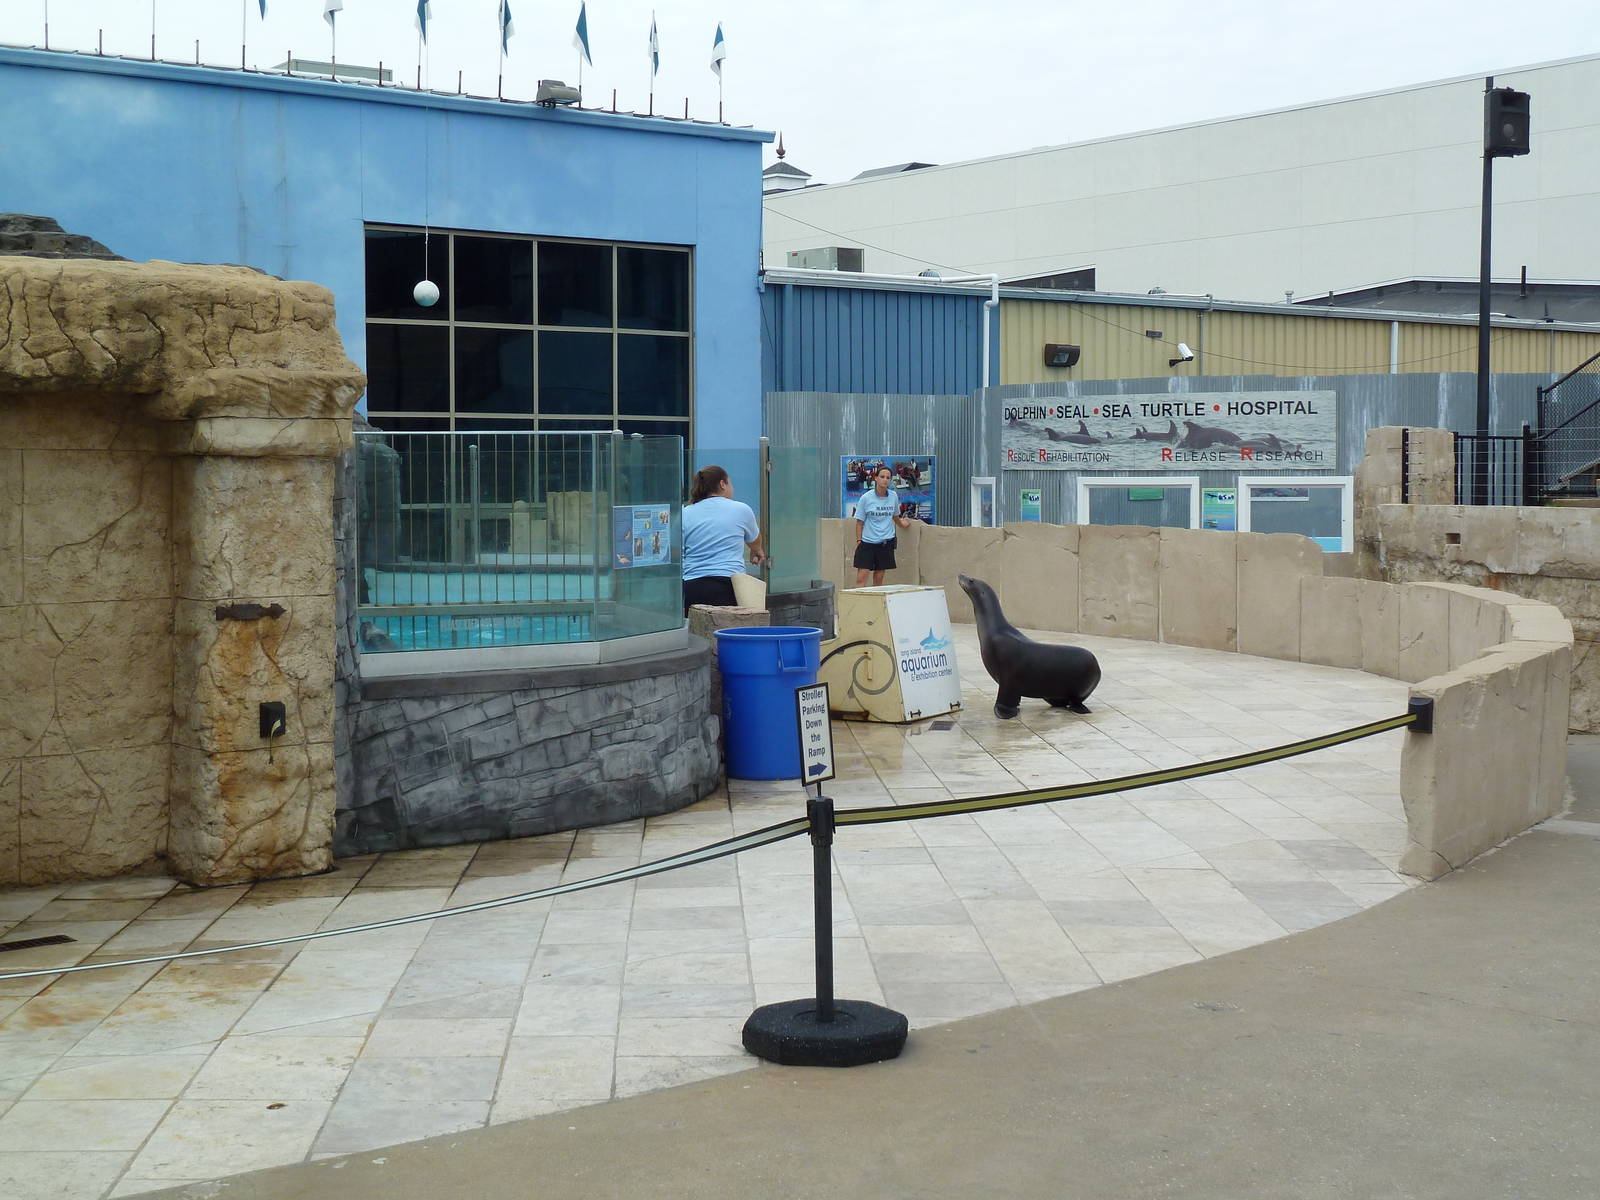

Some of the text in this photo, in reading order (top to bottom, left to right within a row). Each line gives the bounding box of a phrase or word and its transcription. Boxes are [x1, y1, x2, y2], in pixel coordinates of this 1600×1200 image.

[1004, 401, 1318, 420] DOLPHIN SEAL SEA TURTLE HOSPITAL
[1039, 449, 1110, 462] REHABILITATION
[1161, 448, 1227, 462] RELEASE
[1240, 447, 1323, 461] RESEARCH
[901, 652, 948, 675] aquarium
[915, 670, 938, 680] exhibition
[938, 668, 953, 677] center
[801, 690, 823, 701] Stroller
[802, 704, 826, 716] Parking
[806, 719, 822, 730] Down
[810, 733, 821, 742] the
[808, 747, 826, 758] Ramp
